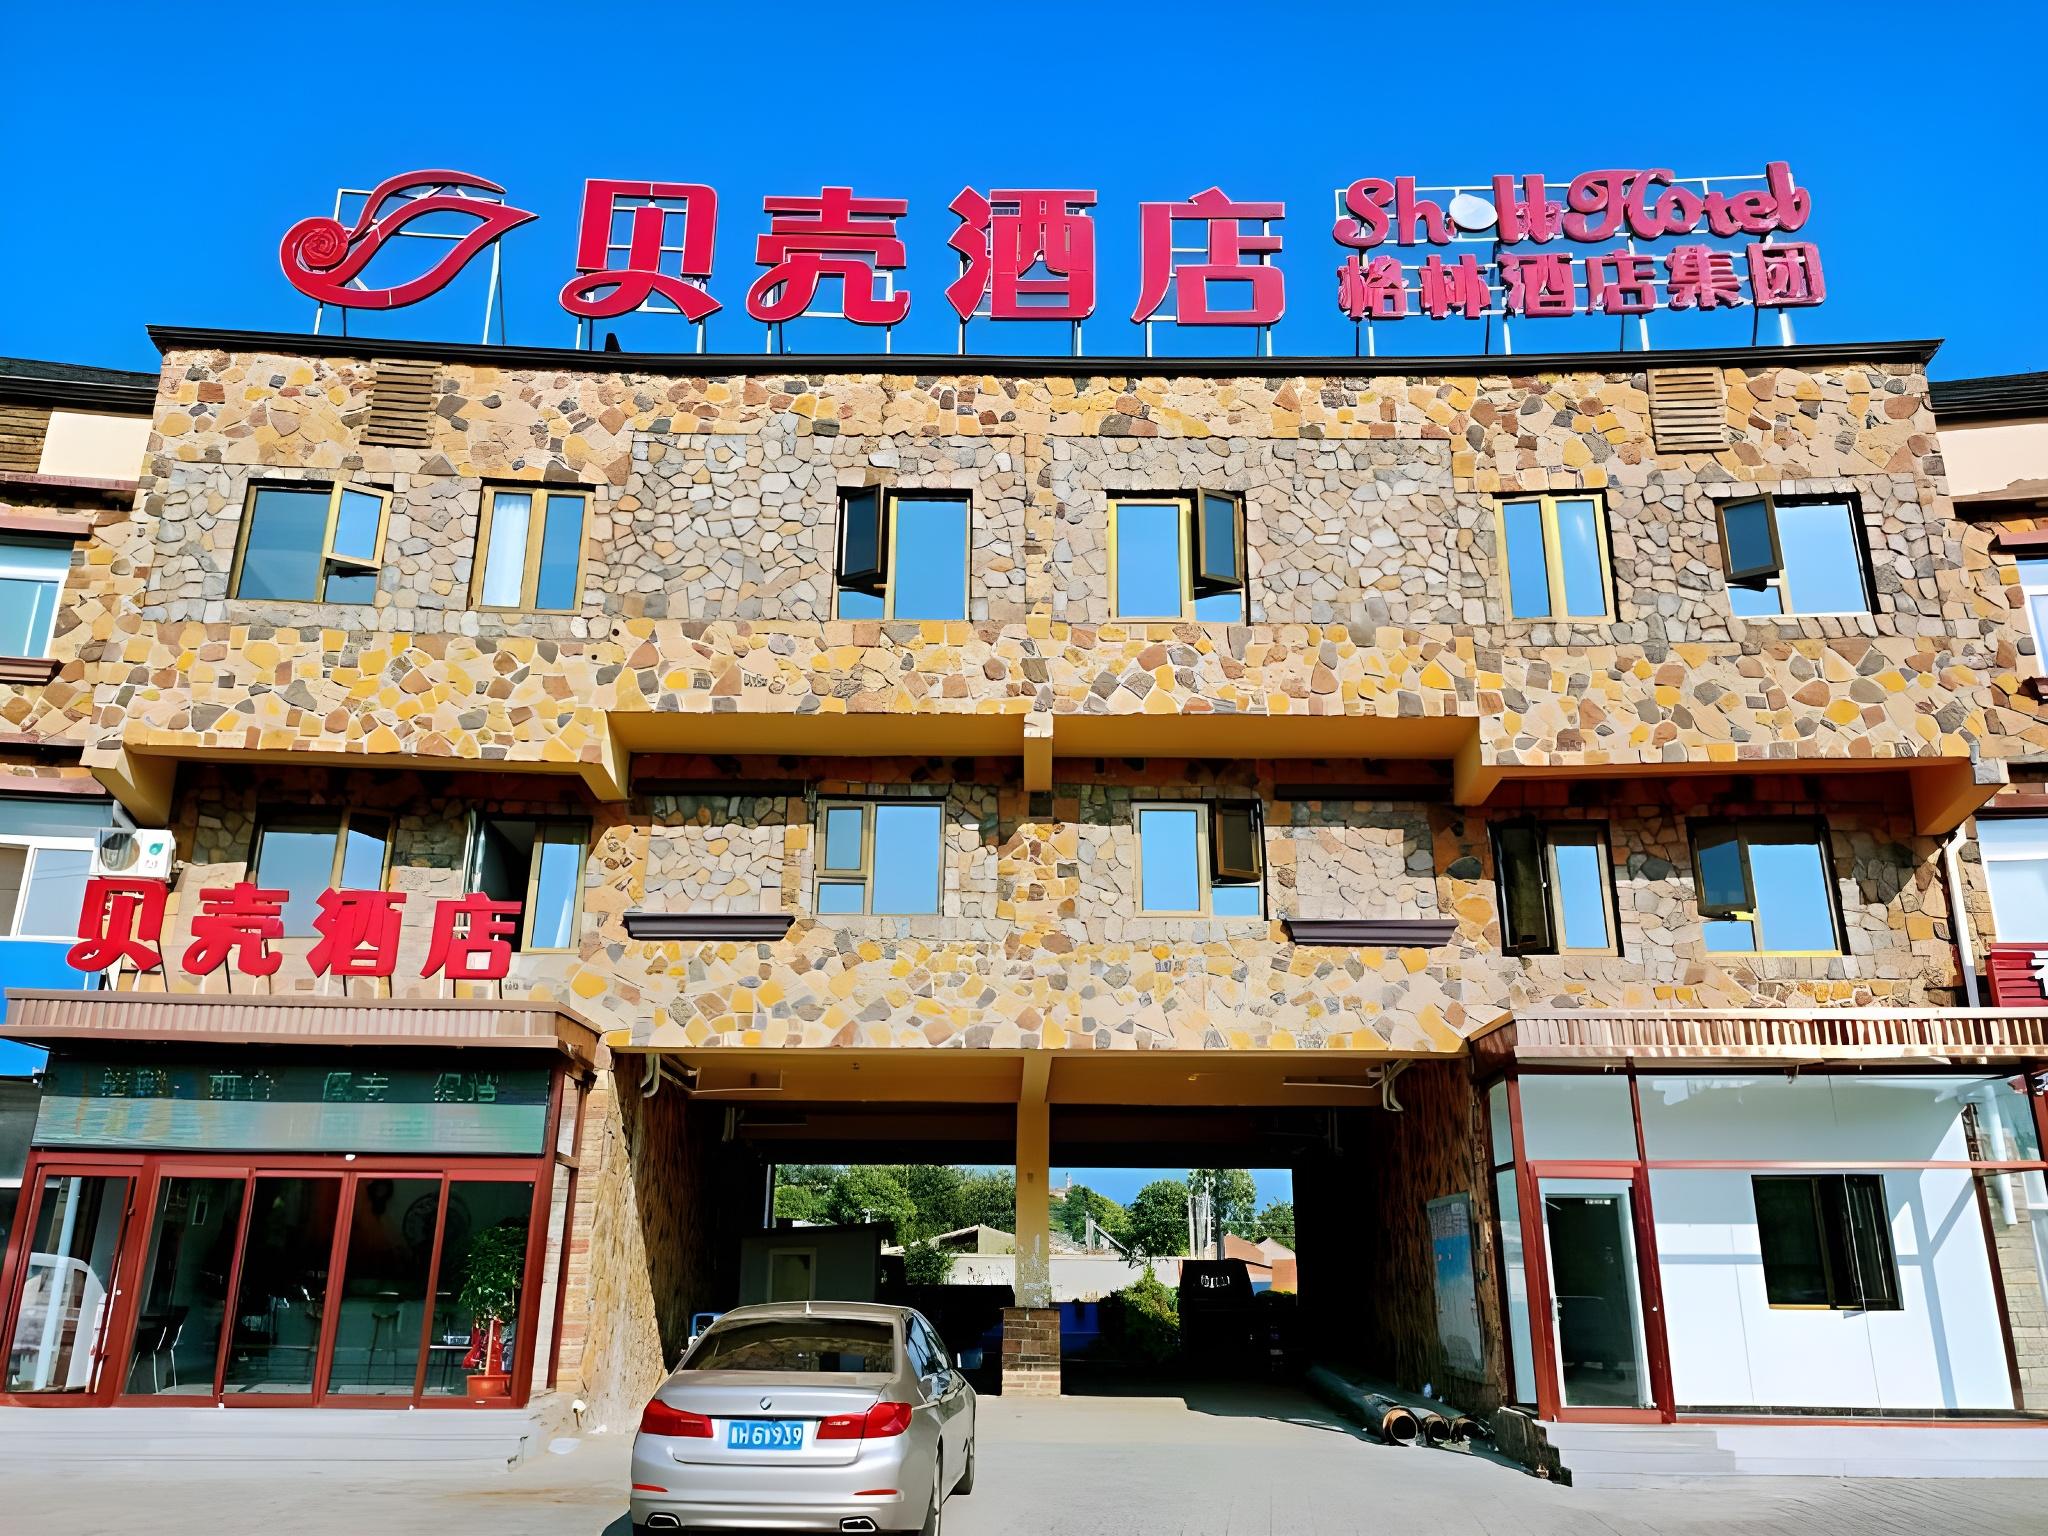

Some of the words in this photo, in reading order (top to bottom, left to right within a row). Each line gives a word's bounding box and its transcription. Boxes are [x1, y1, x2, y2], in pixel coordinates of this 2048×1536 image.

[1333, 174, 1562, 248] Shll
[1562, 160, 1811, 243] Hotel
[559, 178, 1286, 325] 贝壳酒店
[1337, 242, 1827, 320] 格林酒店集团
[66, 879, 522, 980] 贝壳酒店
